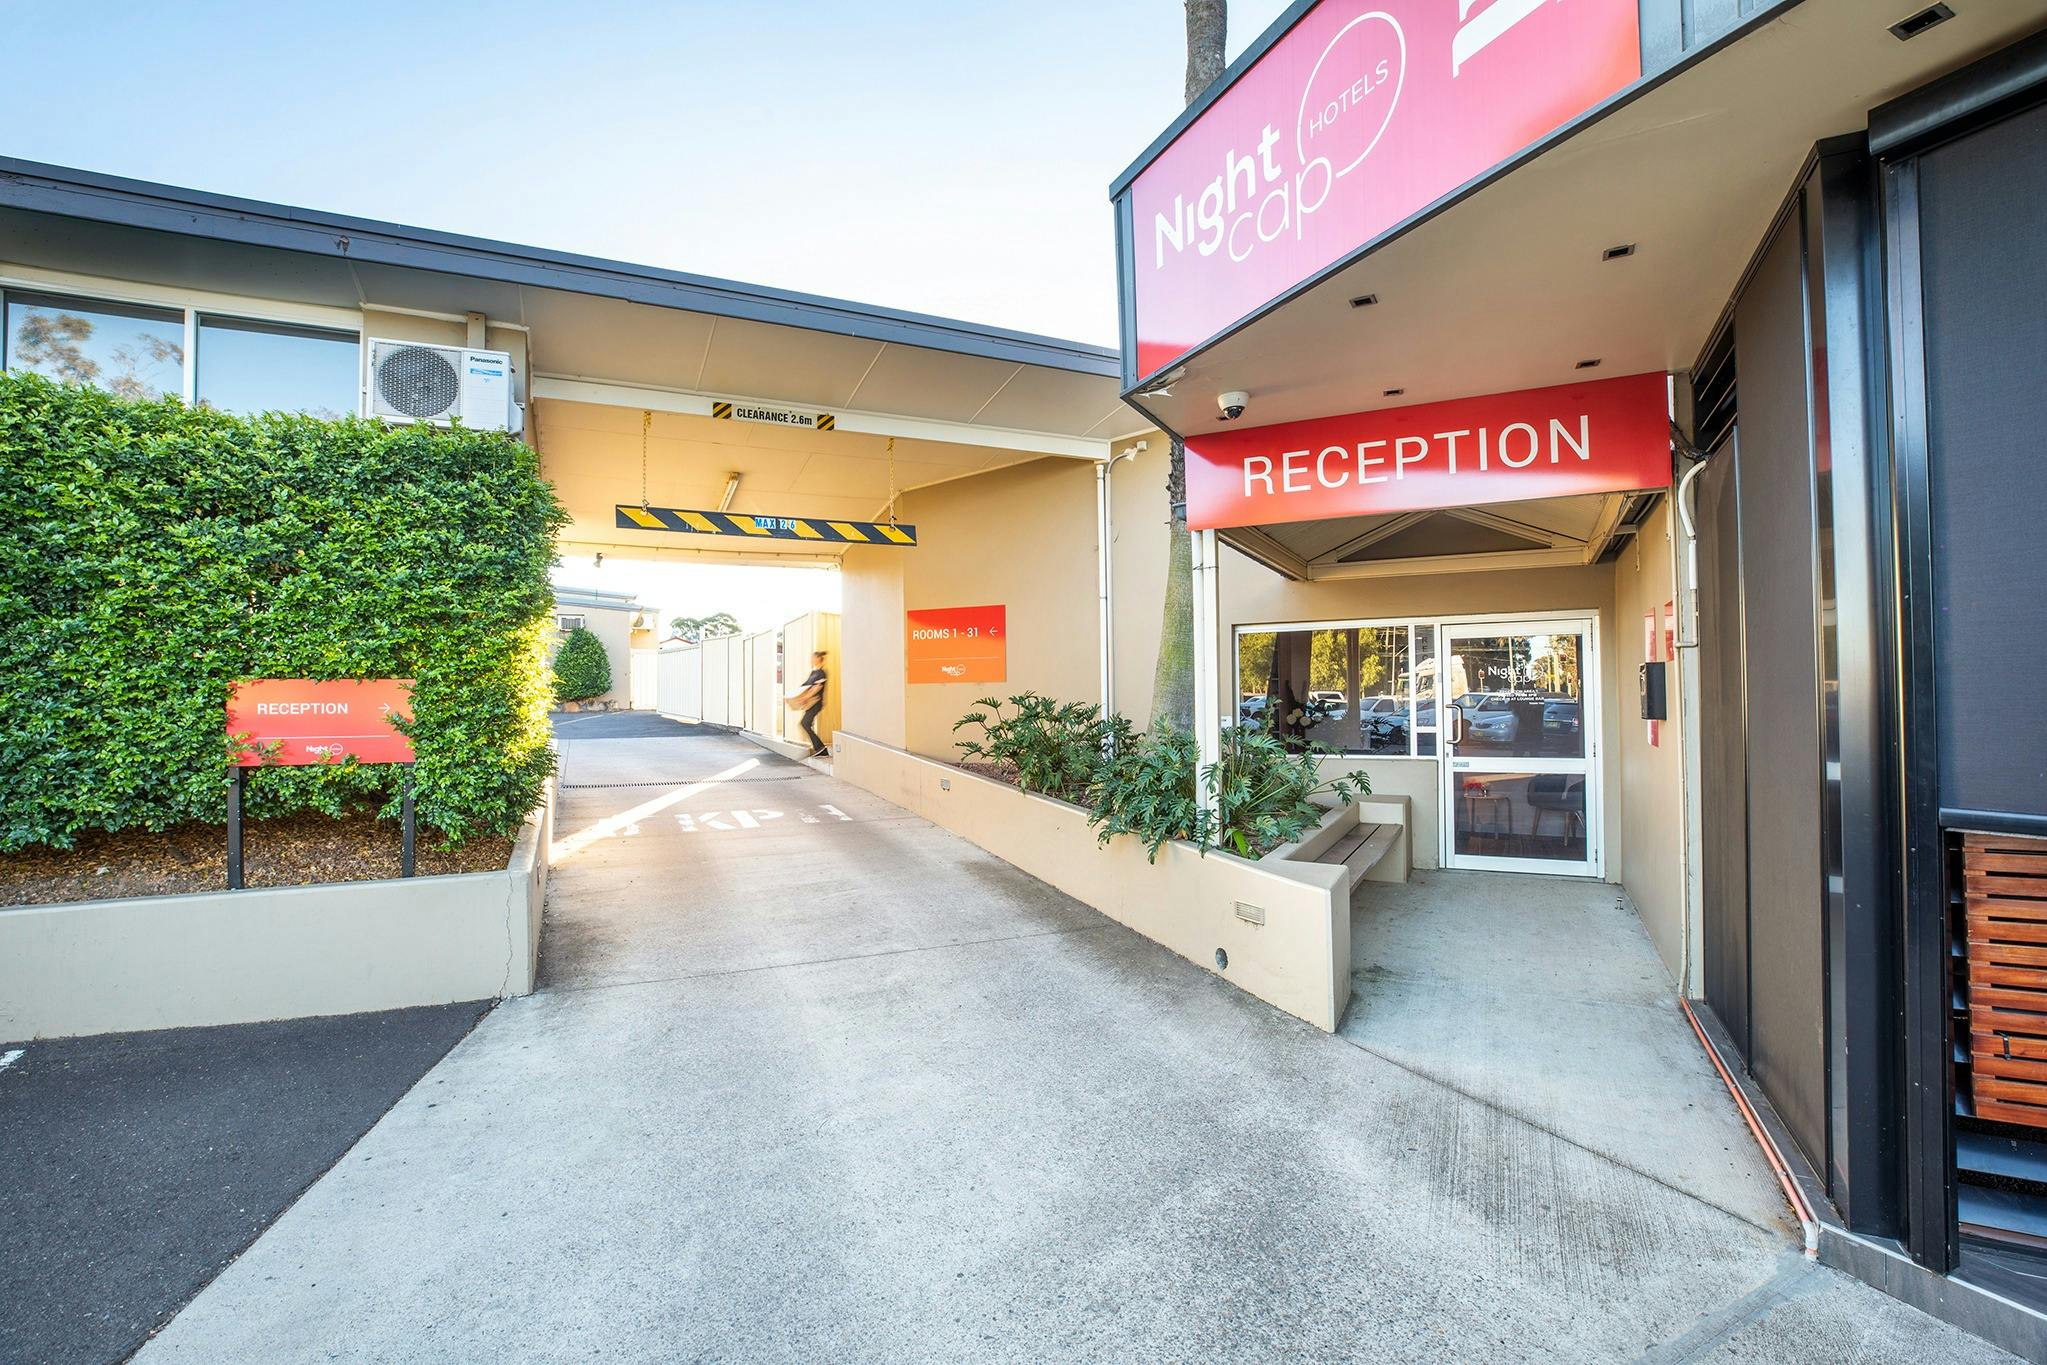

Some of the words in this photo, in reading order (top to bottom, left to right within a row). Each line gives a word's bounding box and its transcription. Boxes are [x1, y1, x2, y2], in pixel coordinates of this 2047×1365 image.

[1309, 59, 1389, 139] HOTELS
[1154, 122, 1282, 270] Night
[1228, 156, 1333, 263] cap
[470, 356, 503, 364] Panasonic
[736, 408, 789, 423] CLEARANCE
[790, 415, 813, 426] 2.6m
[1243, 414, 1590, 497] RECEPTION
[755, 518, 776, 529] MAX
[912, 628, 950, 640] ROOMS
[952, 628, 957, 638] 1
[967, 627, 978, 637] 31
[1488, 666, 1521, 679] Night
[257, 702, 349, 715] RECEPTION
